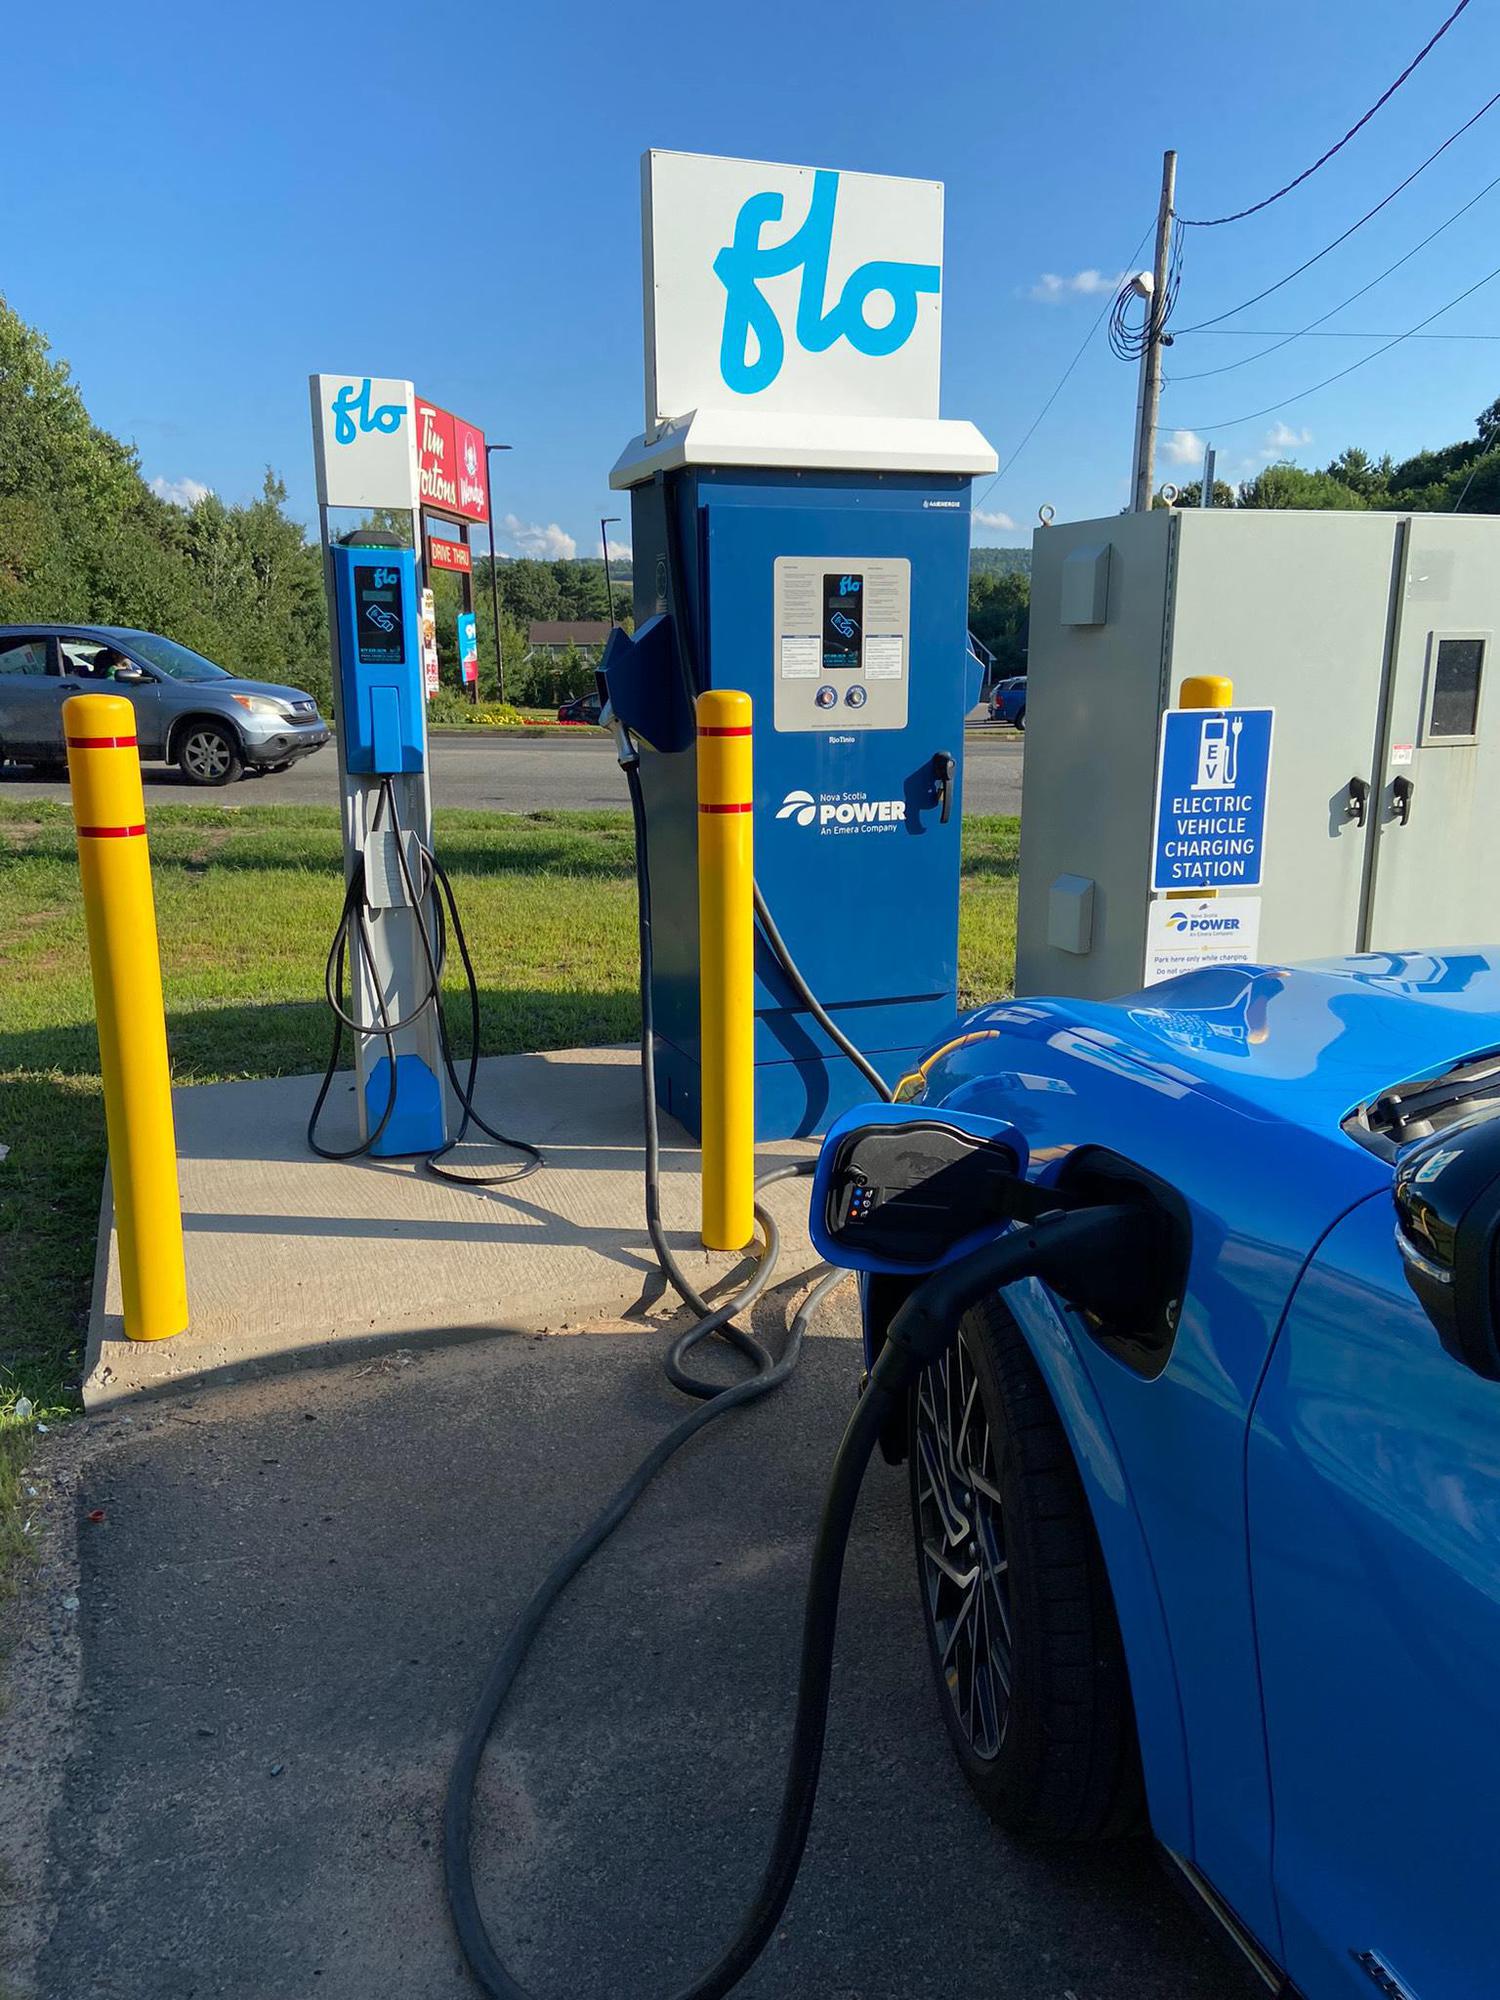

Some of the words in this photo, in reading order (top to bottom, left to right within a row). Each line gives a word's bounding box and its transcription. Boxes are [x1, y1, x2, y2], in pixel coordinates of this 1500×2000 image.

[713, 169, 940, 394] flo
[332, 379, 407, 444] flo
[420, 407, 444, 460] Tim
[432, 543, 451, 563] DRIVE
[453, 547, 469, 567] THRU
[374, 568, 398, 588] flo
[840, 576, 860, 595] flo
[843, 792, 867, 801] Scotia
[1172, 795, 1252, 814] ELECTRIC
[820, 801, 906, 825] POWER
[820, 827, 832, 835] An
[833, 826, 859, 835] Emera
[861, 824, 897, 833] Company
[1177, 818, 1246, 836] VEHICLE
[1165, 839, 1255, 858] CHARGING
[1172, 861, 1245, 879] STATION
[1190, 919, 1240, 931] POWER
[1186, 955, 1200, 963] only
